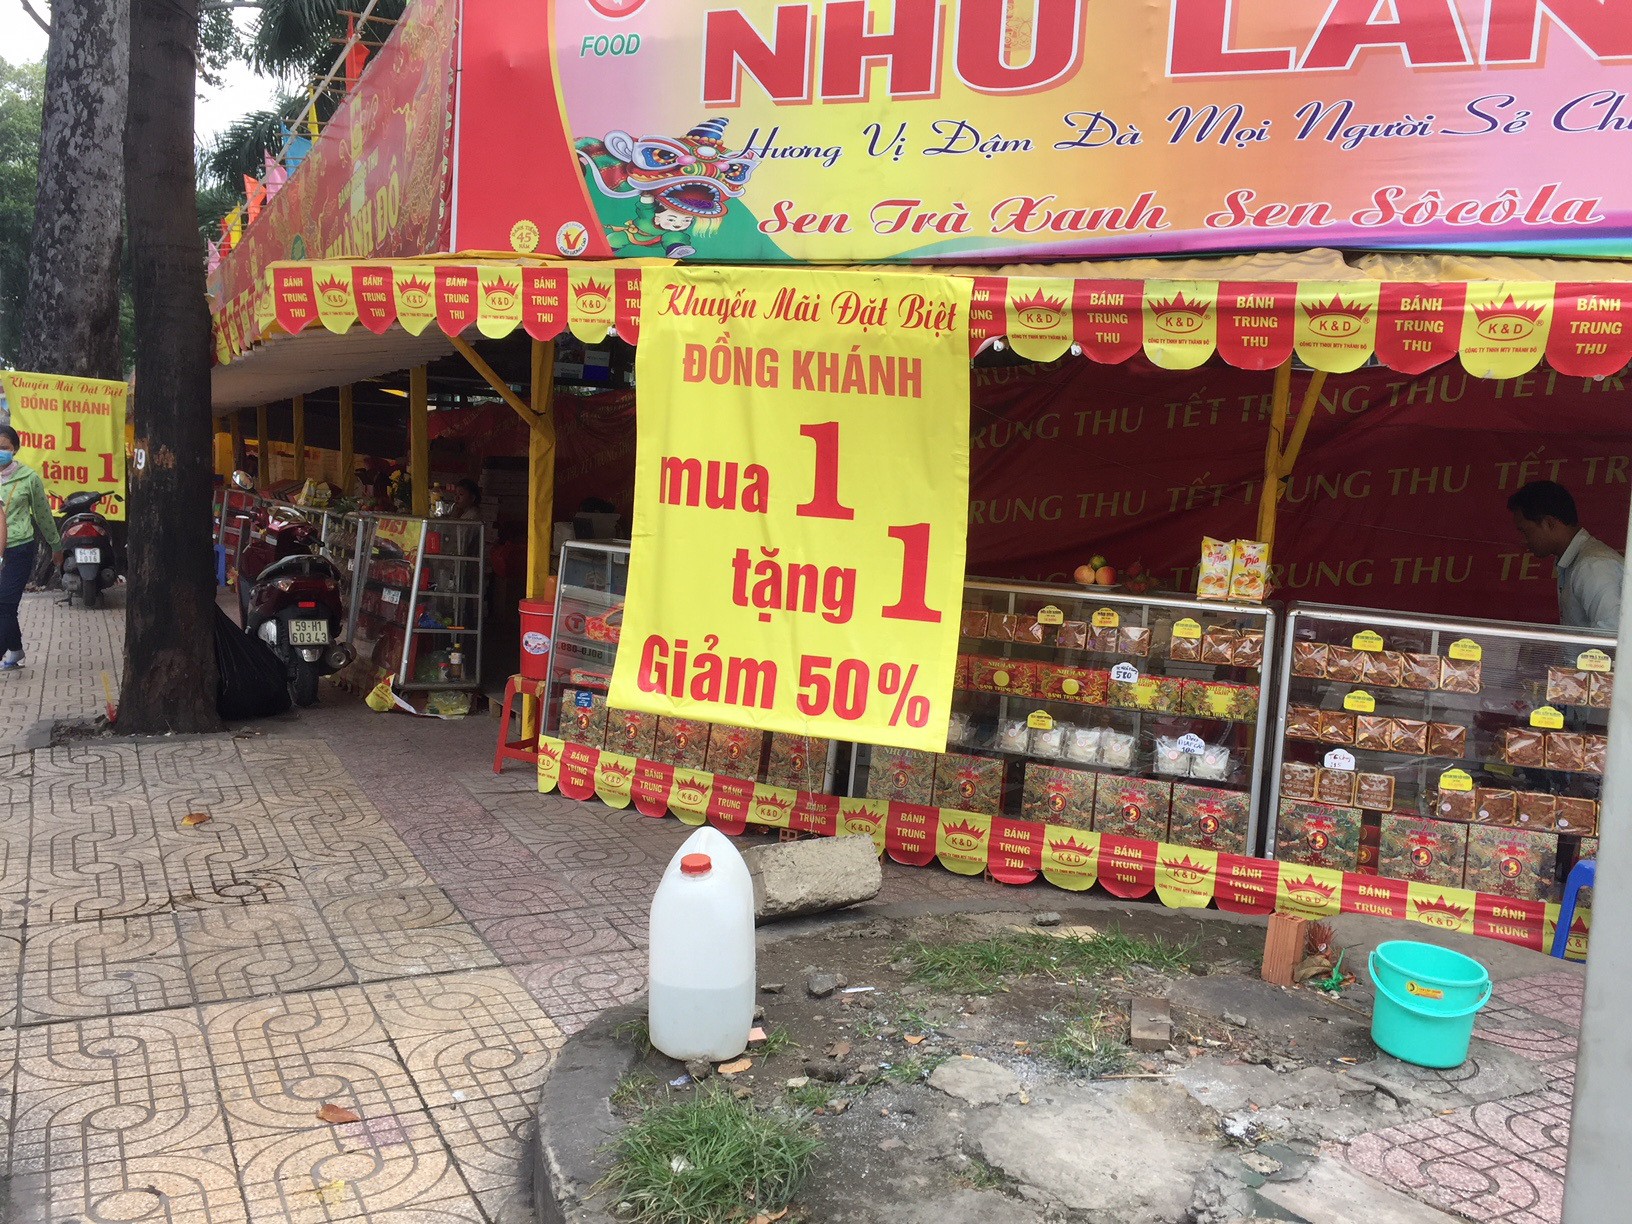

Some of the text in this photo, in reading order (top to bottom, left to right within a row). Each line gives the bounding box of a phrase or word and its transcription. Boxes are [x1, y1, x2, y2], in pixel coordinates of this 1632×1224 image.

[580, 33, 641, 57] FOOD
[719, 126, 842, 168] Hương
[862, 122, 907, 162] Vị
[922, 119, 1034, 159] Đậm
[1053, 111, 1142, 149] Đà
[1166, 103, 1270, 148] Mọi
[1294, 100, 1436, 150] Người
[757, 181, 1606, 234] Sen Trà Xanh Sen Sôcôla
[517, 232, 531, 242] 45
[283, 275, 303, 286] BÁNH
[362, 275, 383, 286] BÁNH
[446, 275, 467, 286] BÁNH
[534, 276, 557, 289] BÁNH
[282, 294, 308, 302] TRUNG
[362, 293, 386, 302] TRUNG
[444, 293, 469, 303] TRUNG
[531, 295, 559, 306] TRUNG
[1090, 290, 1124, 306] BÁNH
[1236, 293, 1275, 309] BÁNH
[1400, 294, 1443, 312] BÁNH
[1577, 294, 1621, 312] BÁNH
[290, 308, 306, 317] THU
[370, 308, 385, 317] THU
[449, 309, 465, 319] THU
[658, 283, 957, 337] Khuyến Mãi Đặt Biệt
[970, 310, 993, 321] UNG
[537, 313, 553, 322] THU
[1026, 313, 1053, 324] K & D
[1087, 312, 1128, 325] TRUNG
[1165, 317, 1194, 328] K & D
[1233, 315, 1278, 328] TRUNG
[1319, 321, 1351, 332] K & D
[1394, 320, 1444, 333] TRUNG
[1488, 324, 1523, 335] K & D
[1570, 321, 1622, 335] TRUNG
[969, 328, 986, 339] HU
[1096, 332, 1120, 344] THU
[1242, 336, 1269, 348] THU
[1402, 339, 1432, 352] THU
[1576, 343, 1607, 355] THU
[683, 332, 922, 399] ĐỒNG KHÁNH
[10, 376, 50, 391] Khuyến
[51, 380, 74, 394] Mãi
[21, 393, 110, 415] ĐỒNG KHÁNH
[971, 413, 1061, 450] RUNG
[1073, 406, 1144, 437] THU
[1164, 386, 1226, 429] TẾT
[1387, 373, 1466, 407] THU
[18, 421, 87, 452] mua 1
[42, 453, 119, 484] tặng 1
[659, 421, 855, 520] mua 1
[969, 495, 1063, 524] RUNG
[1076, 490, 1147, 518] THU
[1167, 472, 1229, 512] TẾT
[1239, 470, 1372, 505] TUNG
[1387, 464, 1471, 496] THU
[731, 522, 942, 625] tặng 1
[1267, 556, 1473, 589] RUNG THU
[292, 632, 328, 643] 603.43
[637, 633, 931, 729] Giảm 50%
[570, 751, 589, 763] BÁNH
[567, 763, 588, 776] TRUNG
[645, 767, 664, 780] BÁNH
[570, 777, 584, 787] THU
[640, 781, 663, 793] TRUNG
[722, 784, 743, 796] BÁNH
[641, 795, 656, 804] THU
[717, 798, 741, 810] TRUNG
[718, 812, 733, 821] THU
[901, 811, 926, 824] BÁNH
[896, 828, 926, 840] TRUNG
[1004, 827, 1030, 841] BÁNH
[901, 842, 920, 853] THU
[999, 842, 1031, 855] TRUNG
[1114, 845, 1142, 859] BÁNH
[1005, 858, 1024, 868] THU
[1232, 865, 1263, 879] BÁNH
[1116, 874, 1137, 884] THU
[1358, 883, 1390, 899] BÁNH
[1234, 893, 1256, 905] THU
[1354, 902, 1393, 916] TRUNG
[1492, 906, 1527, 921] BÁNH
[1488, 923, 1530, 939] TRUNG
